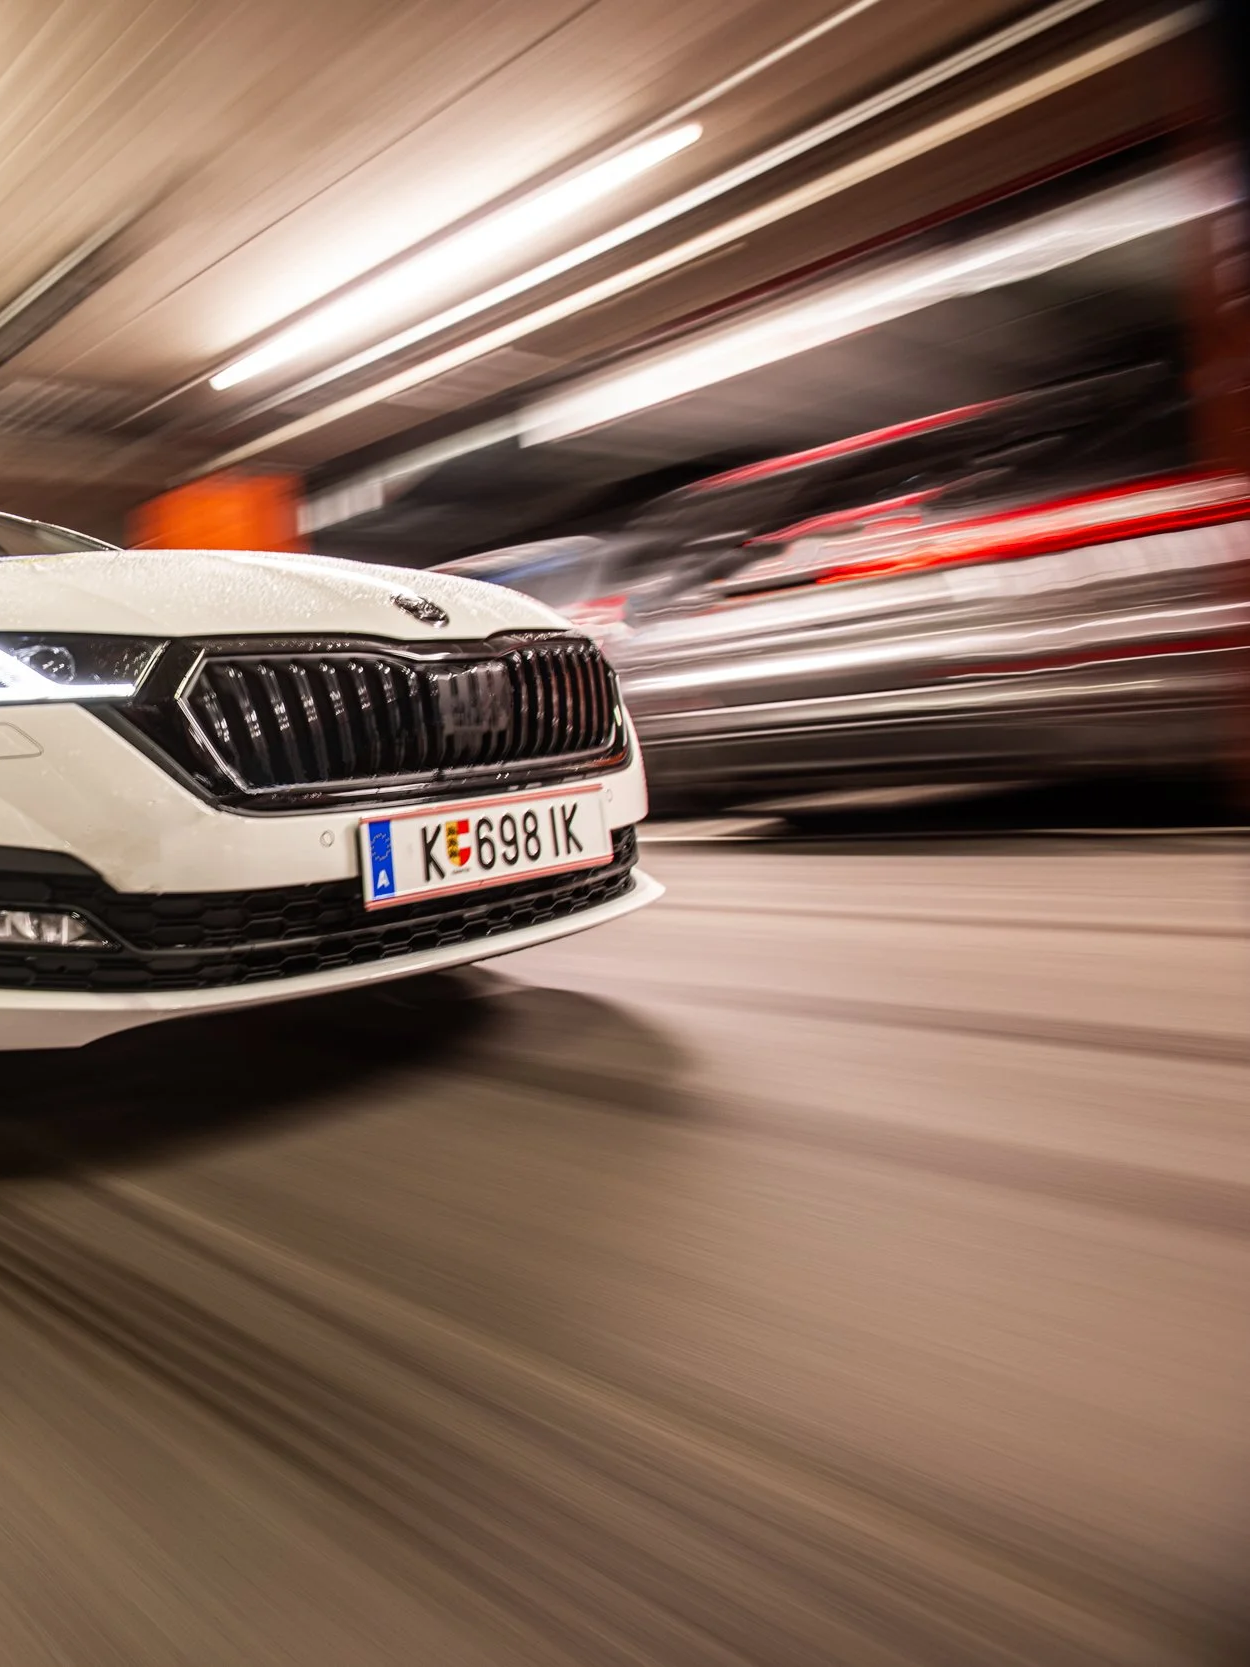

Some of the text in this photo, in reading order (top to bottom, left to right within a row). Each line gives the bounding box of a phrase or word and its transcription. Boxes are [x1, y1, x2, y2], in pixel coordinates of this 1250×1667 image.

[421, 802, 584, 882] K 698 IK
[376, 868, 390, 889] A
